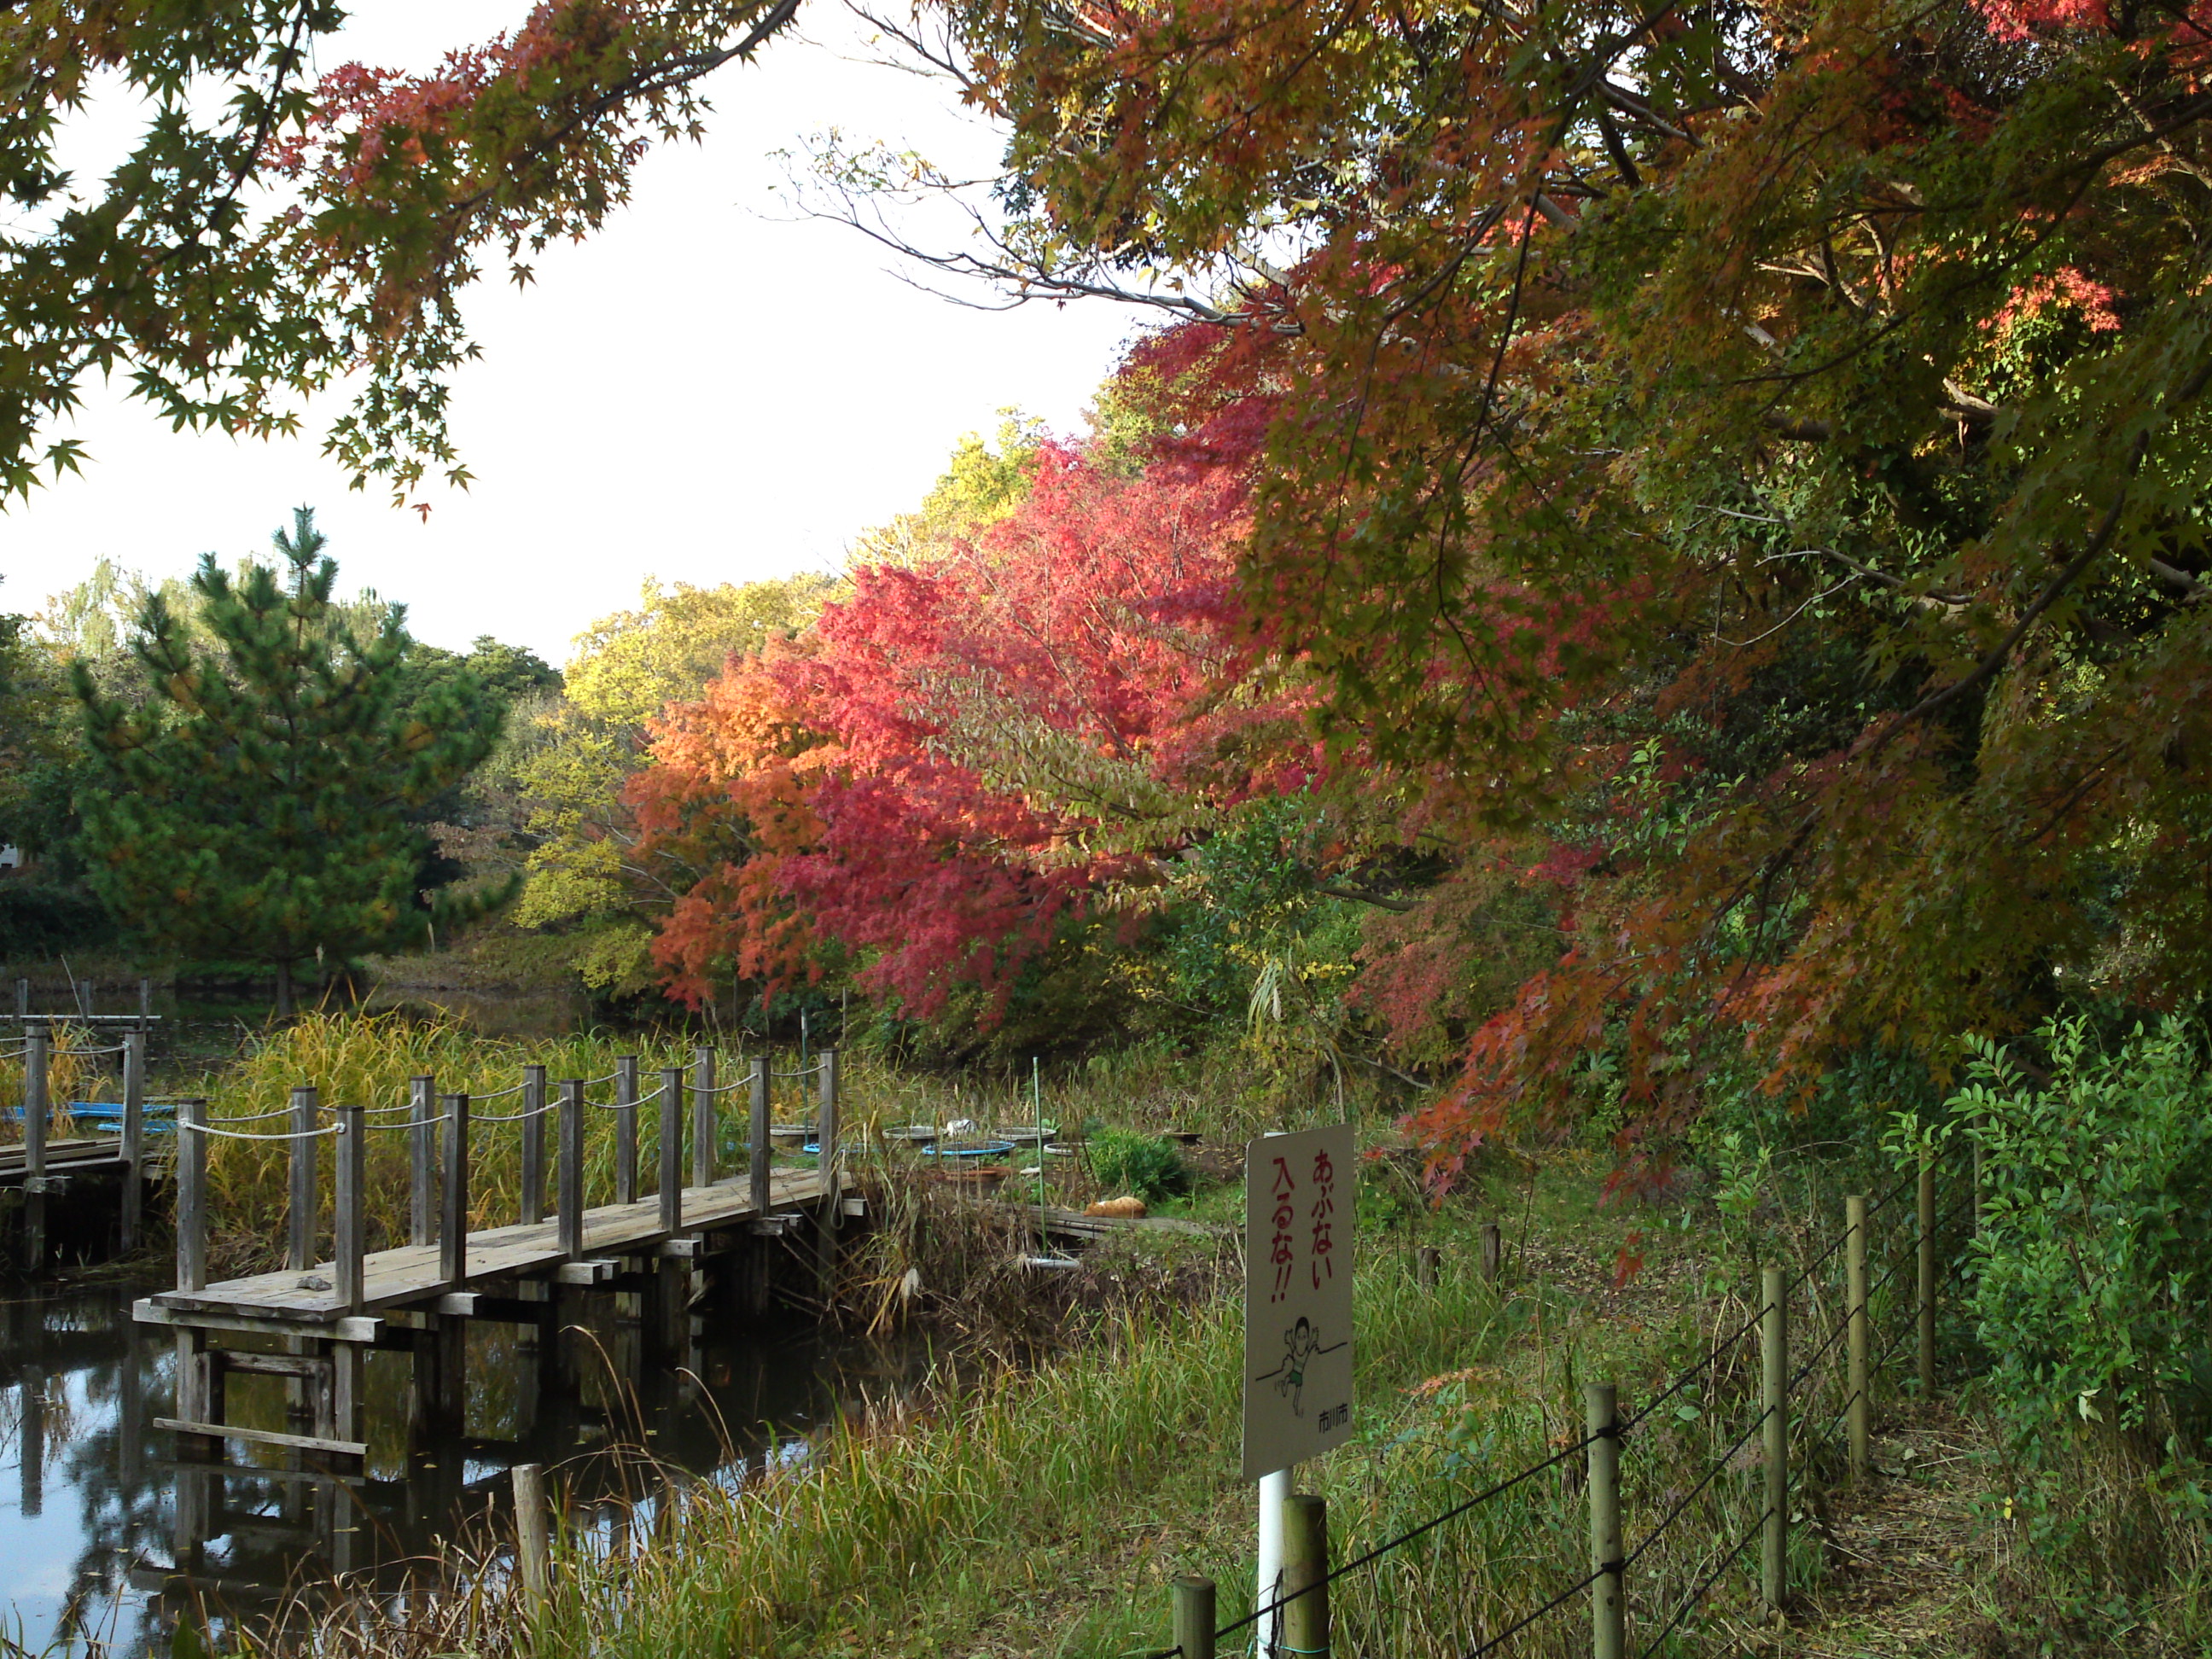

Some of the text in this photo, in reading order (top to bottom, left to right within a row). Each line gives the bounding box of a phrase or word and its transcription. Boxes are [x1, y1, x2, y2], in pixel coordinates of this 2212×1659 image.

[1311, 1149, 1334, 1290] あぶない
[1318, 1402, 1348, 1435] 市川市
